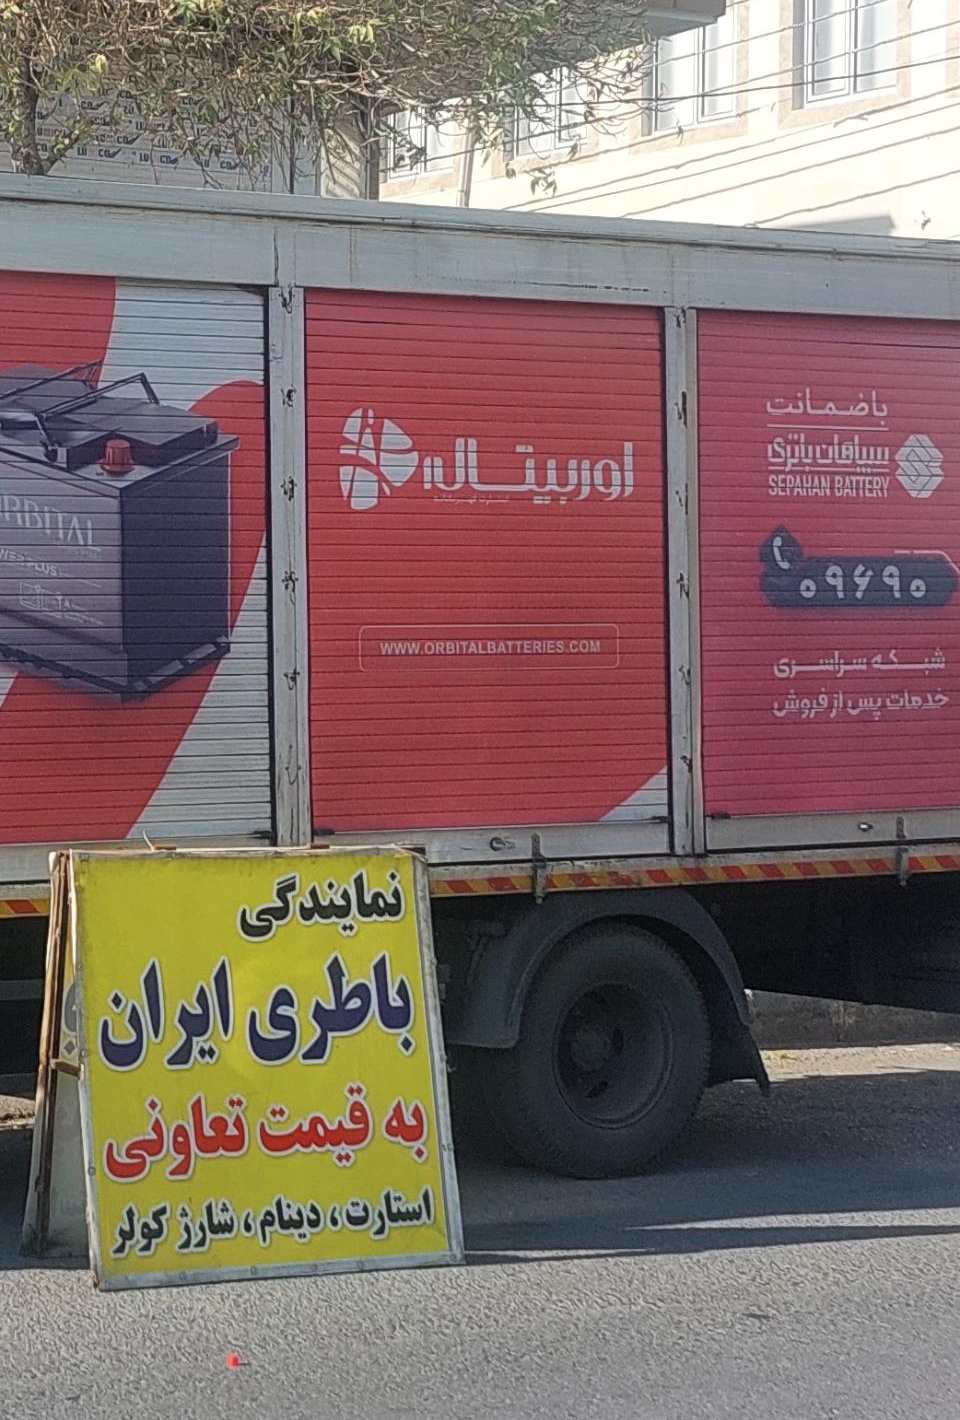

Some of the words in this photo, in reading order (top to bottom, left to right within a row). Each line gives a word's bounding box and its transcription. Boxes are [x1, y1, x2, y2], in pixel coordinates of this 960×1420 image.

[768, 475, 831, 496] SEPAHAN
[835, 476, 890, 497] BATTERY
[800, 564, 927, 599] ۰۹۶۹۰
[380, 641, 601, 656] WWW.ORBITALBATTERIES.COM
[773, 650, 868, 678] سراسری
[773, 687, 829, 718] فروش
[830, 690, 843, 718] از
[847, 696, 882, 720] پس
[886, 687, 950, 709] خدمات
[239, 870, 403, 938] نمایندگی
[100, 957, 233, 1067] ایران
[248, 953, 415, 1064] باطری
[105, 1095, 246, 1180] تعاونی
[258, 1082, 371, 1165] قیمت
[384, 1098, 427, 1160] به
[112, 1204, 168, 1254] کولر
[176, 1200, 236, 1251] شارژ
[258, 1196, 322, 1244] دینام
[345, 1187, 433, 1236] استارت
